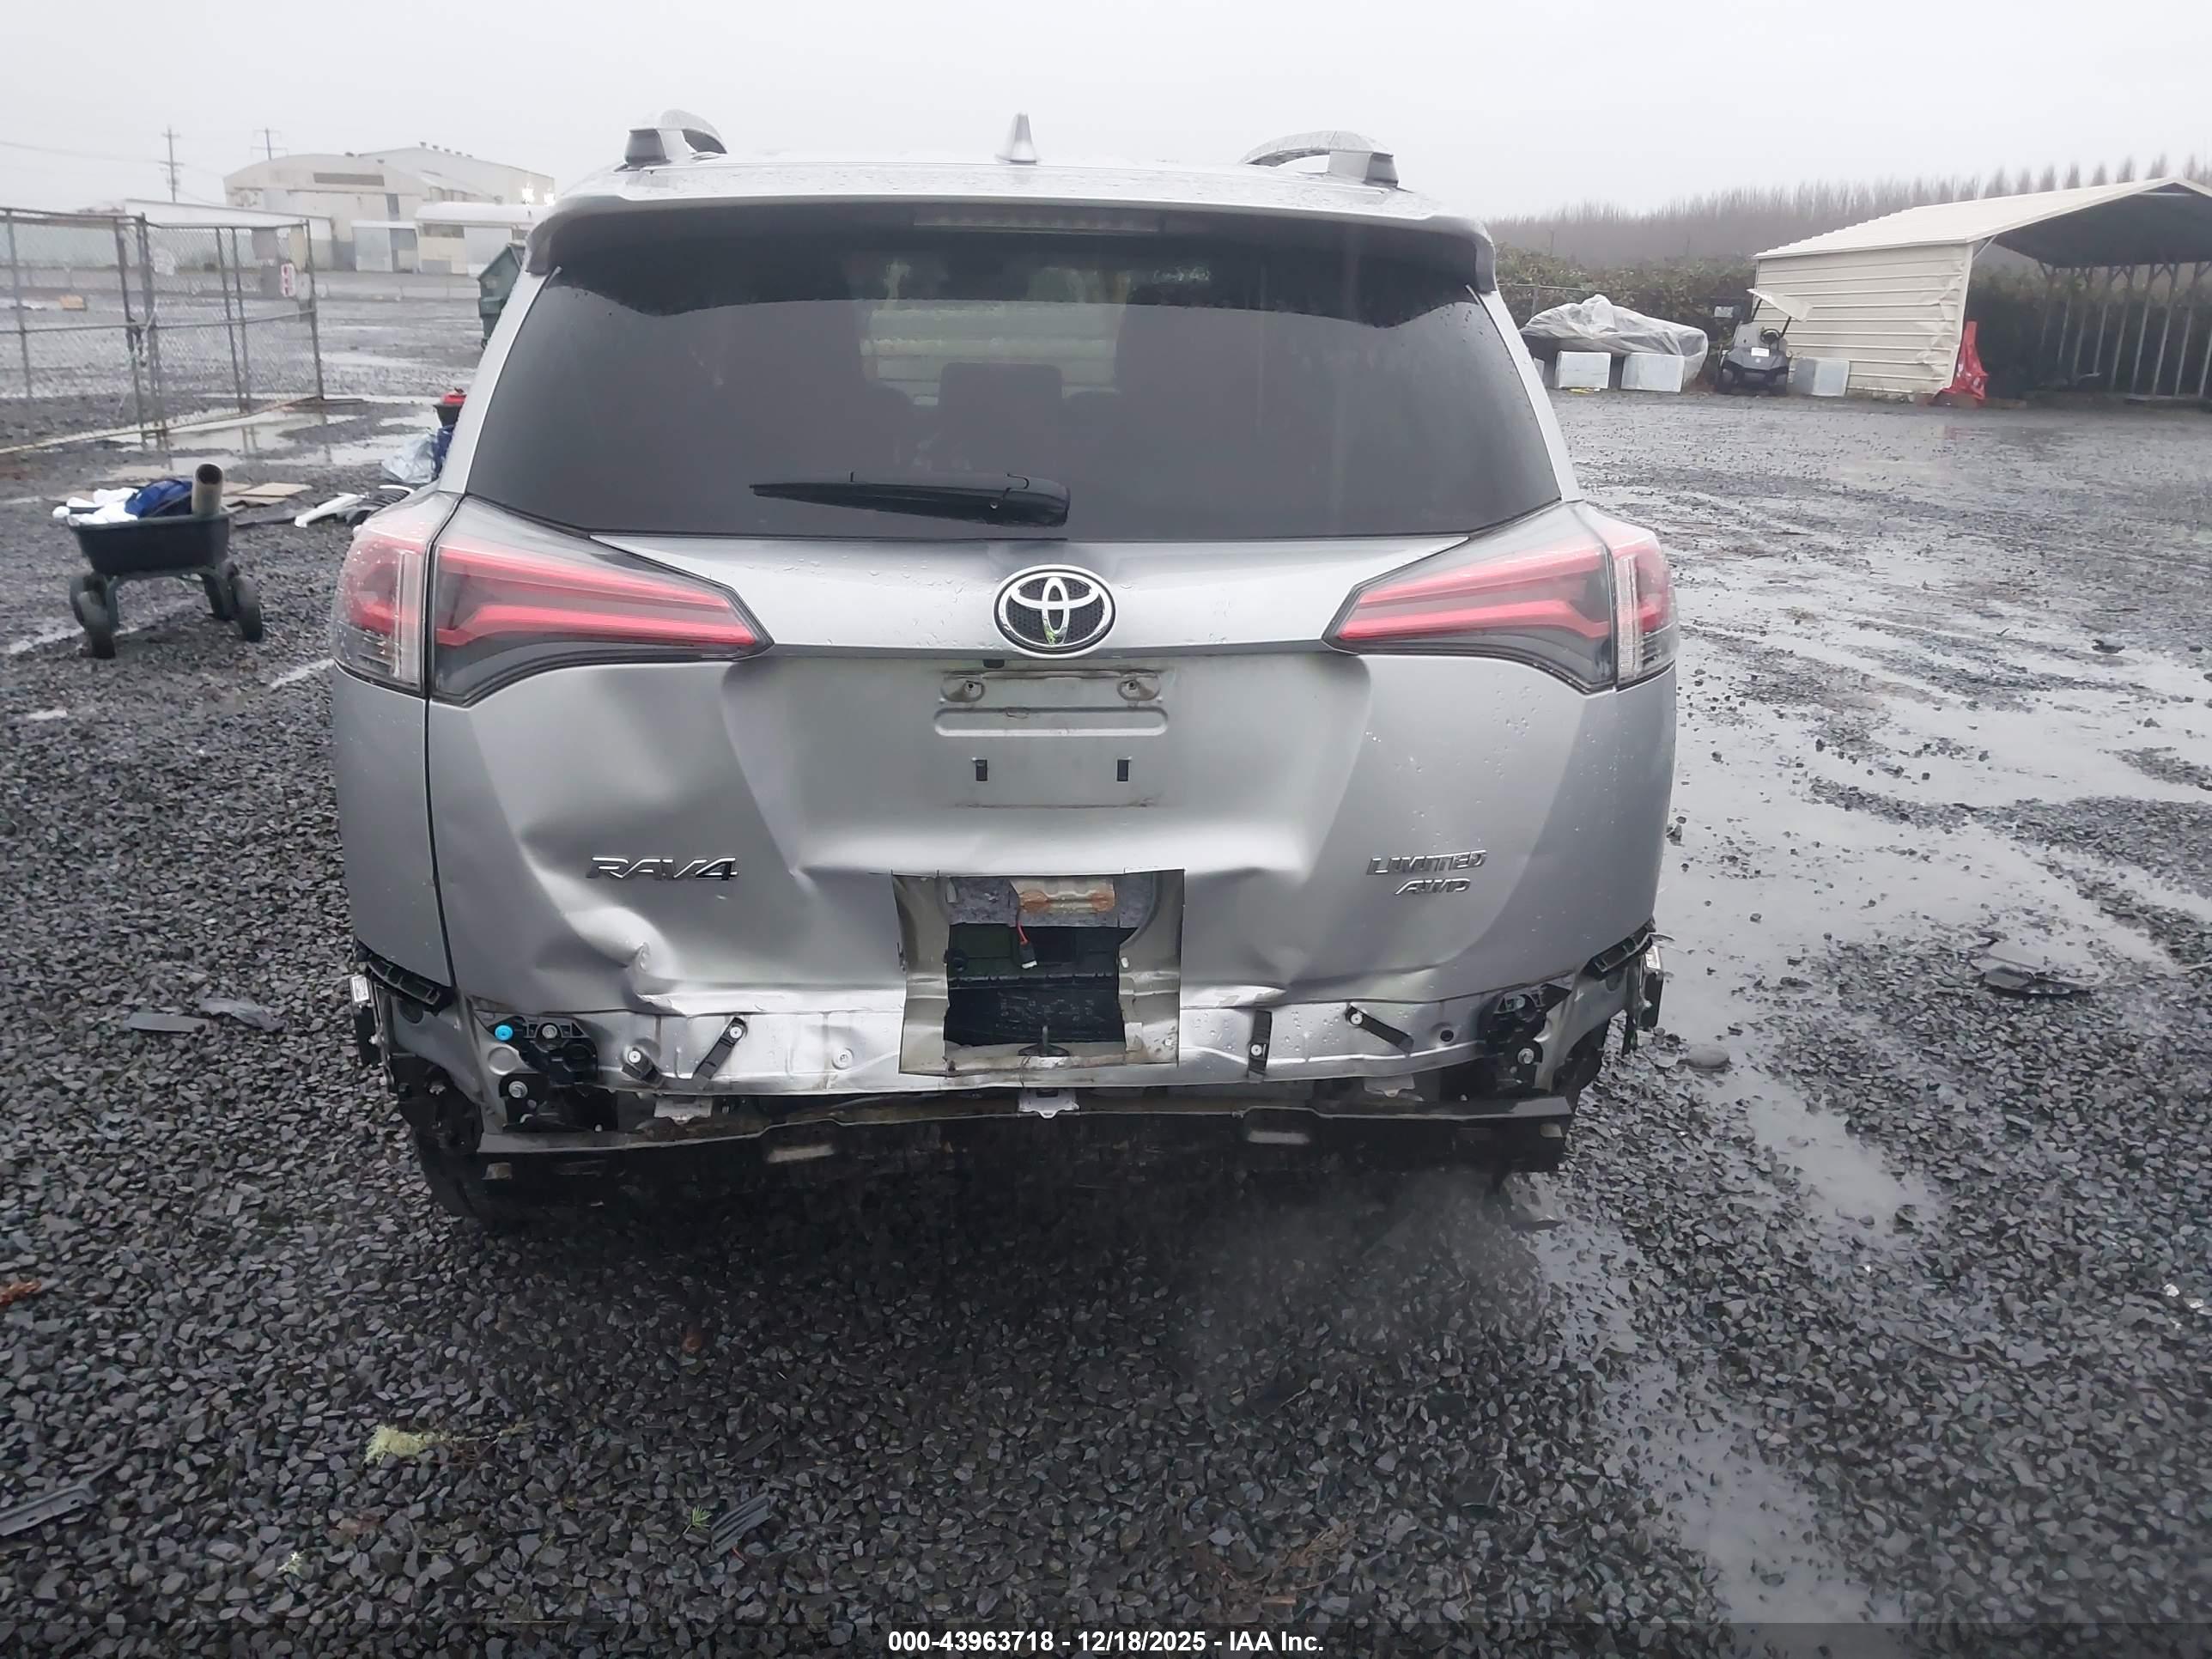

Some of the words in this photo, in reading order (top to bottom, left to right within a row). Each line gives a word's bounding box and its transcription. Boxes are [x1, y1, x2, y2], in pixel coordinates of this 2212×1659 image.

[586, 855, 738, 881] RAV4
[1367, 849, 1487, 875] LIMITED
[1395, 878, 1471, 896] AWD
